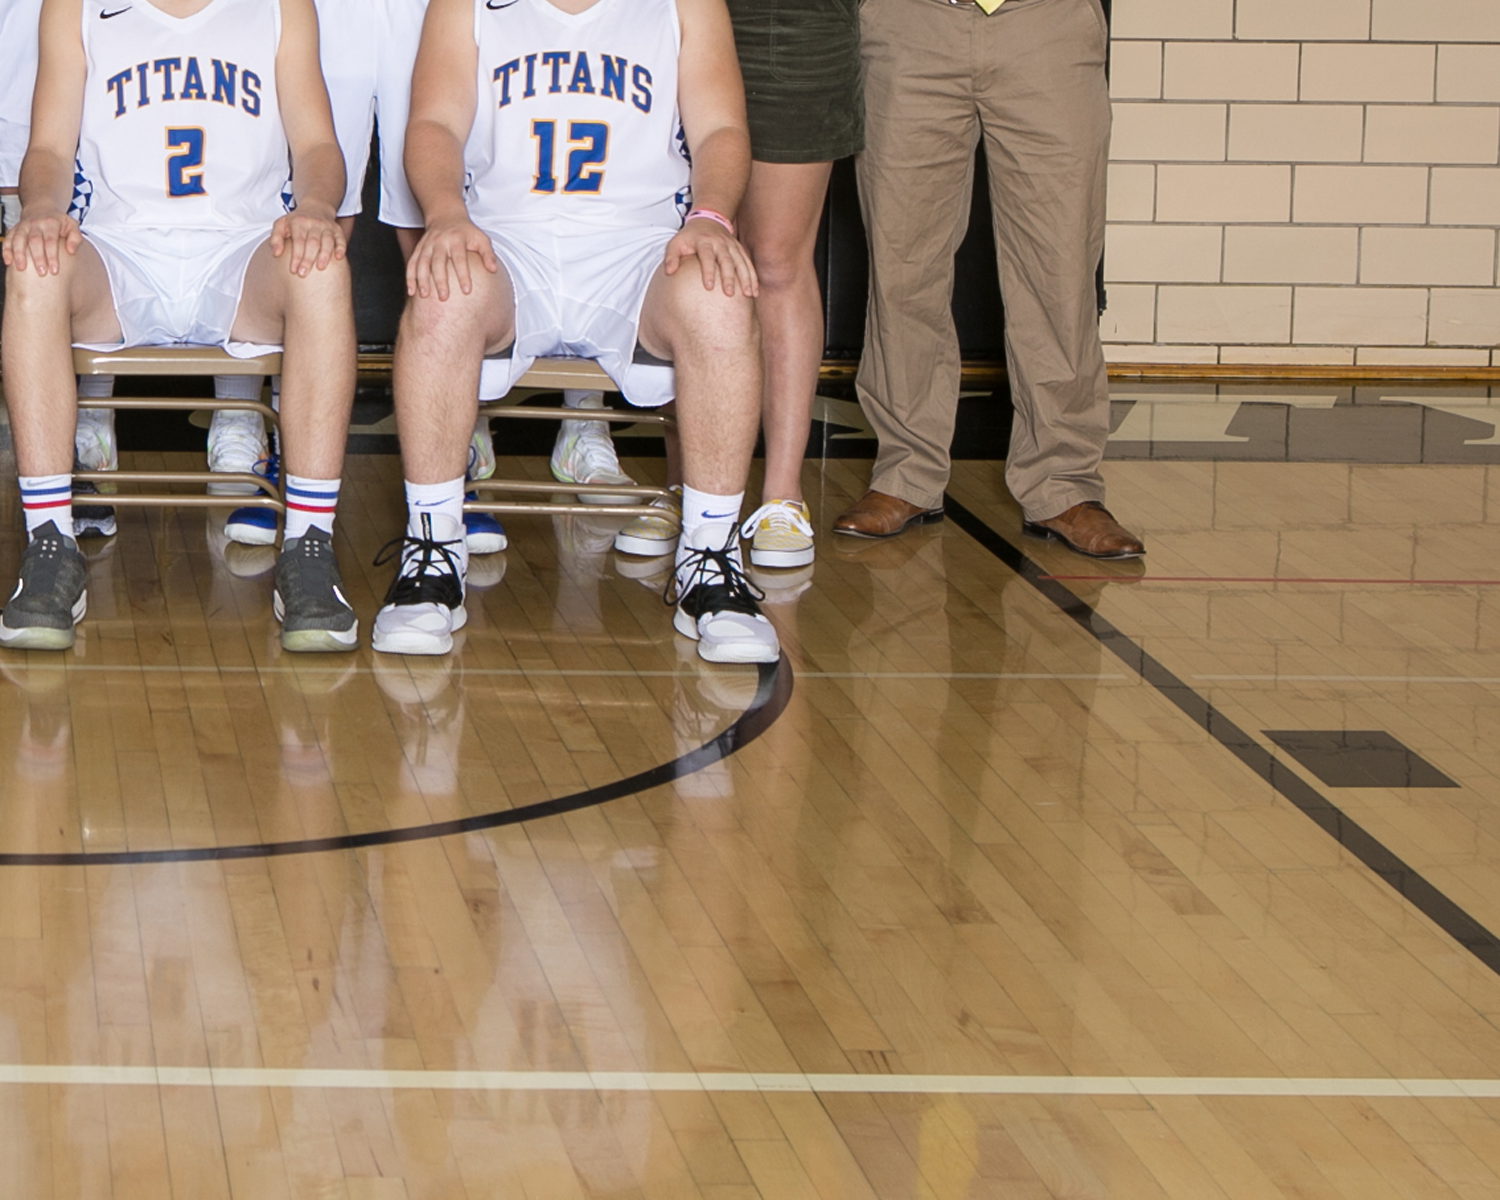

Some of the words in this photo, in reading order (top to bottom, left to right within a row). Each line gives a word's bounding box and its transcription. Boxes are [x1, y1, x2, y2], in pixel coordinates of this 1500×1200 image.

[106, 56, 262, 118] TITANS
[492, 50, 653, 114] TITANS
[164, 125, 209, 199] 2
[529, 117, 611, 196] 12
